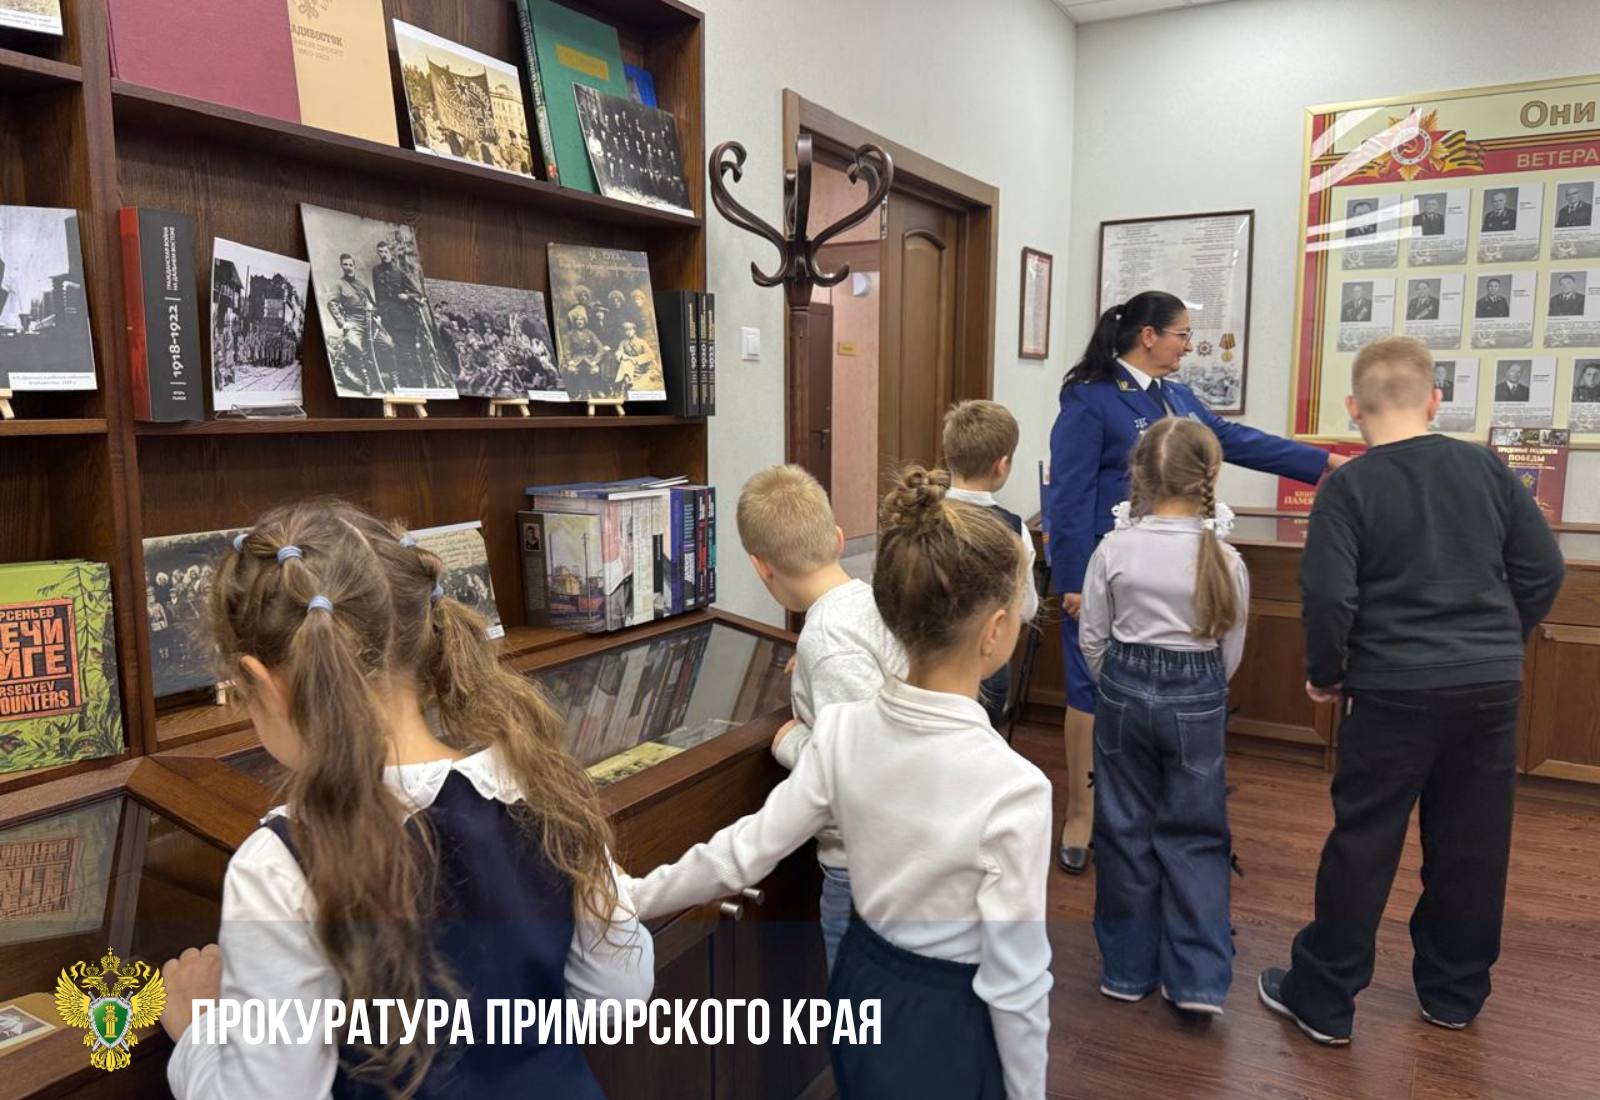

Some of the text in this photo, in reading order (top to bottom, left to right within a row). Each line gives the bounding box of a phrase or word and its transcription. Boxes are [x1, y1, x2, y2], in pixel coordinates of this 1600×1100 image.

[1520, 100, 1596, 128] Они
[168, 304, 184, 378] 1918-1922
[1508, 454, 1545, 462] ПОБЕДЫ
